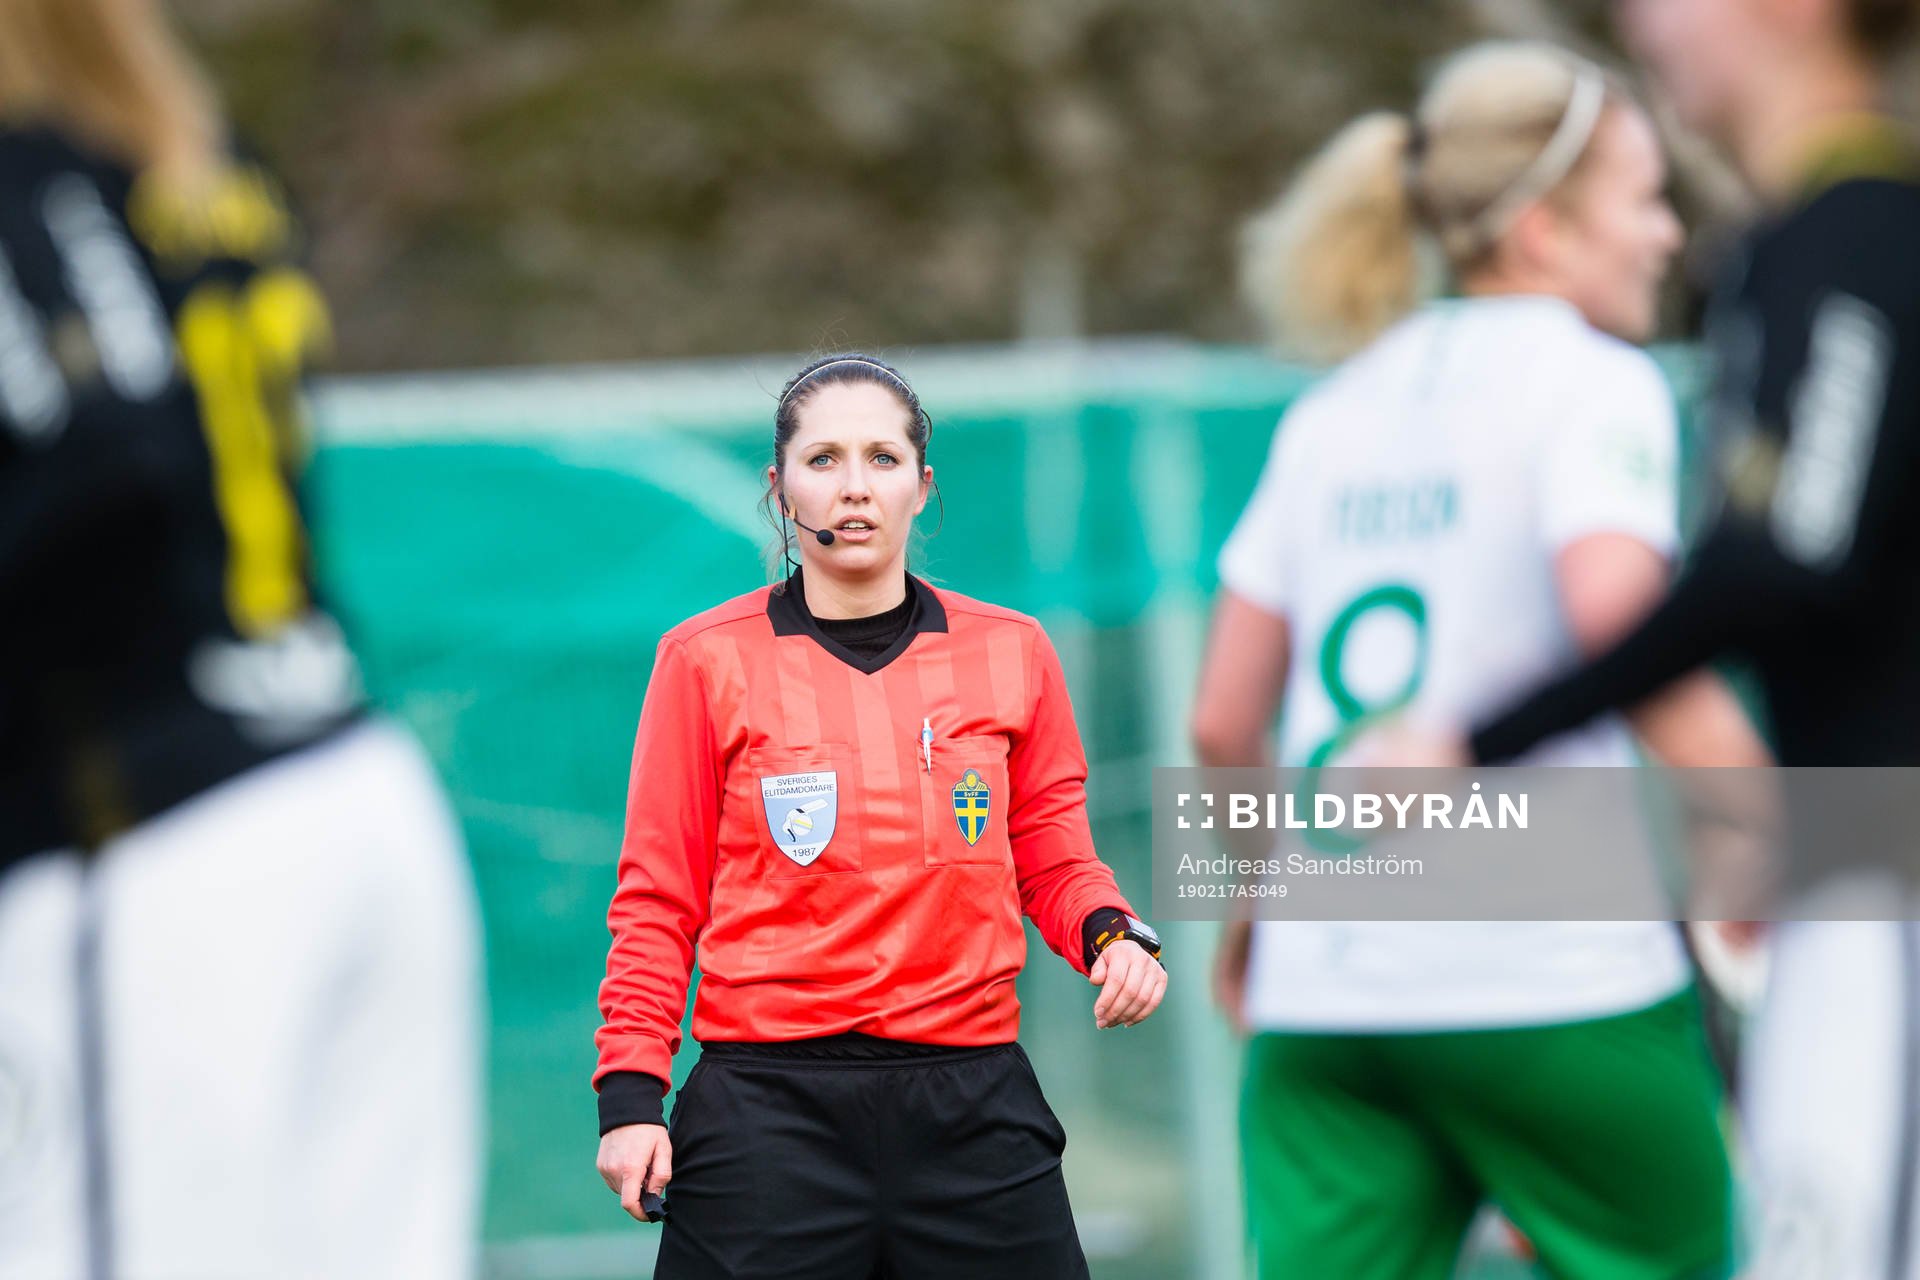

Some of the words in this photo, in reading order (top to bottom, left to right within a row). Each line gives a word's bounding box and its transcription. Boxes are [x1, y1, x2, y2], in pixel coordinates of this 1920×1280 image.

[776, 775, 818, 787] SVERIGES
[764, 783, 835, 798] ELITDAMDOMARE
[792, 847, 817, 857] 1987
